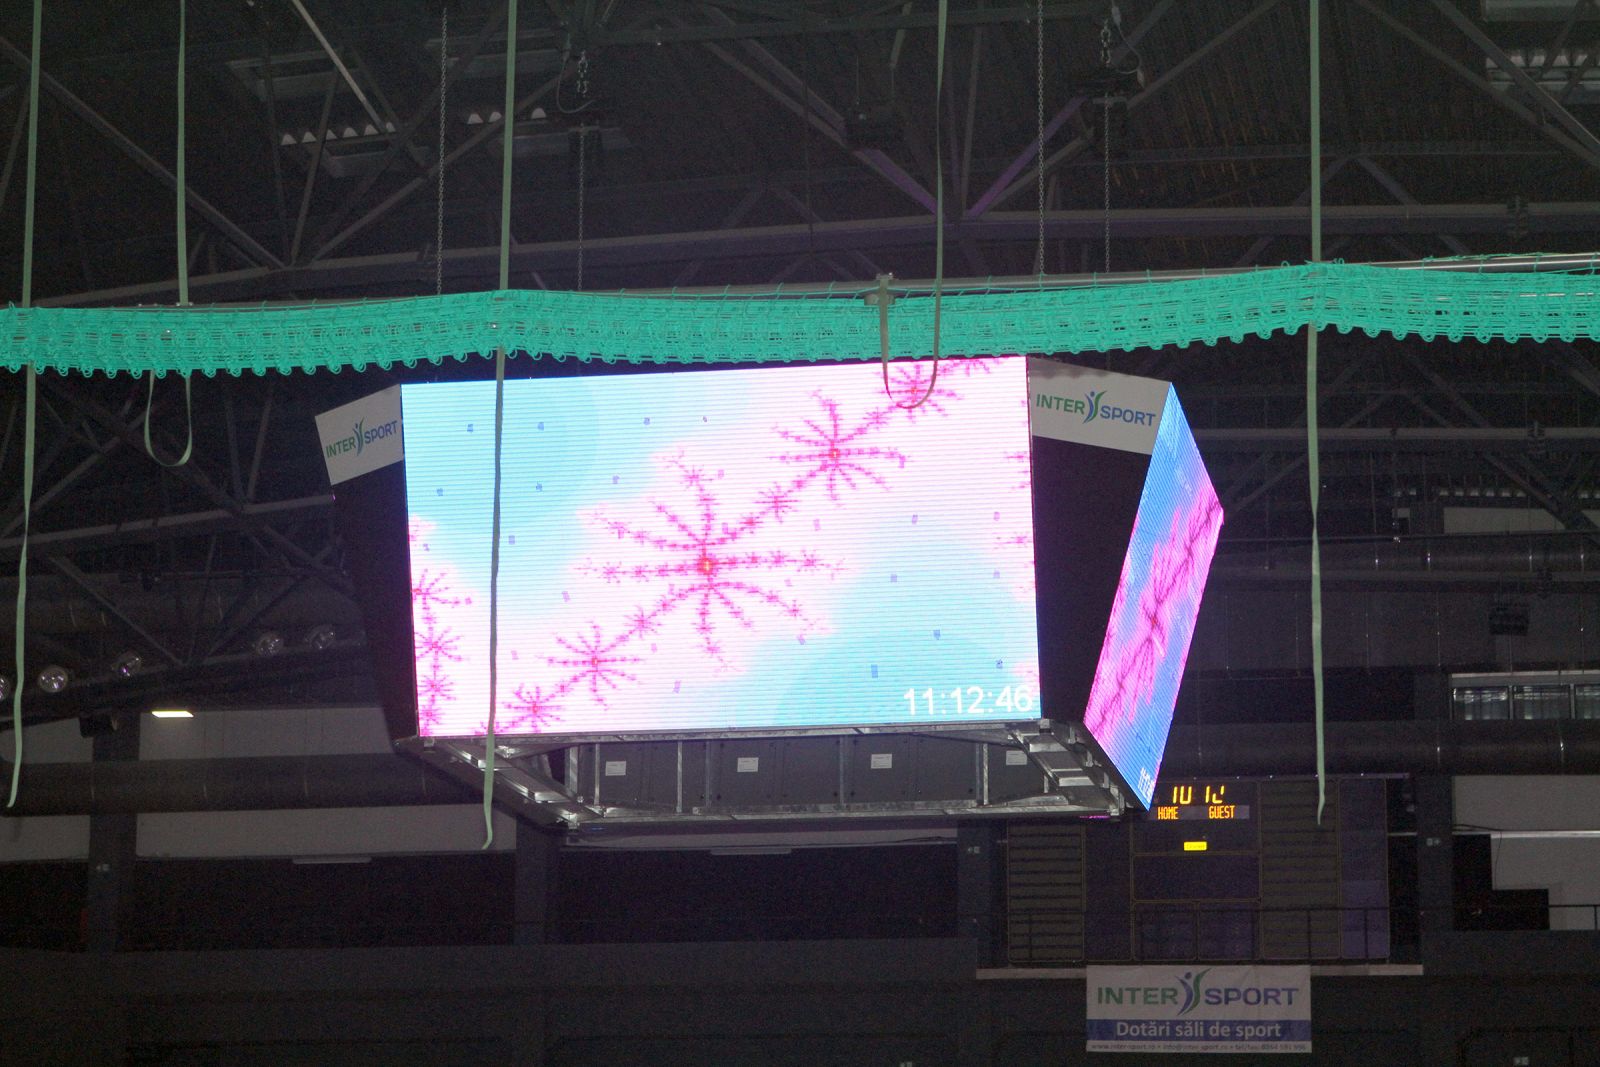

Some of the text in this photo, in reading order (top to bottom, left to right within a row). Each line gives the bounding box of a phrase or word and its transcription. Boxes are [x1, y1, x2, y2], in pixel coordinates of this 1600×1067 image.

[1036, 393, 1156, 427] INTER SPORT
[325, 420, 399, 459] INTER SPORT
[903, 684, 1034, 716] 11:12:46
[1157, 805, 1236, 820] HOME GUEST
[1097, 986, 1300, 1006] INTER SPORT
[1116, 1020, 1281, 1040] Dotări săli de sport
